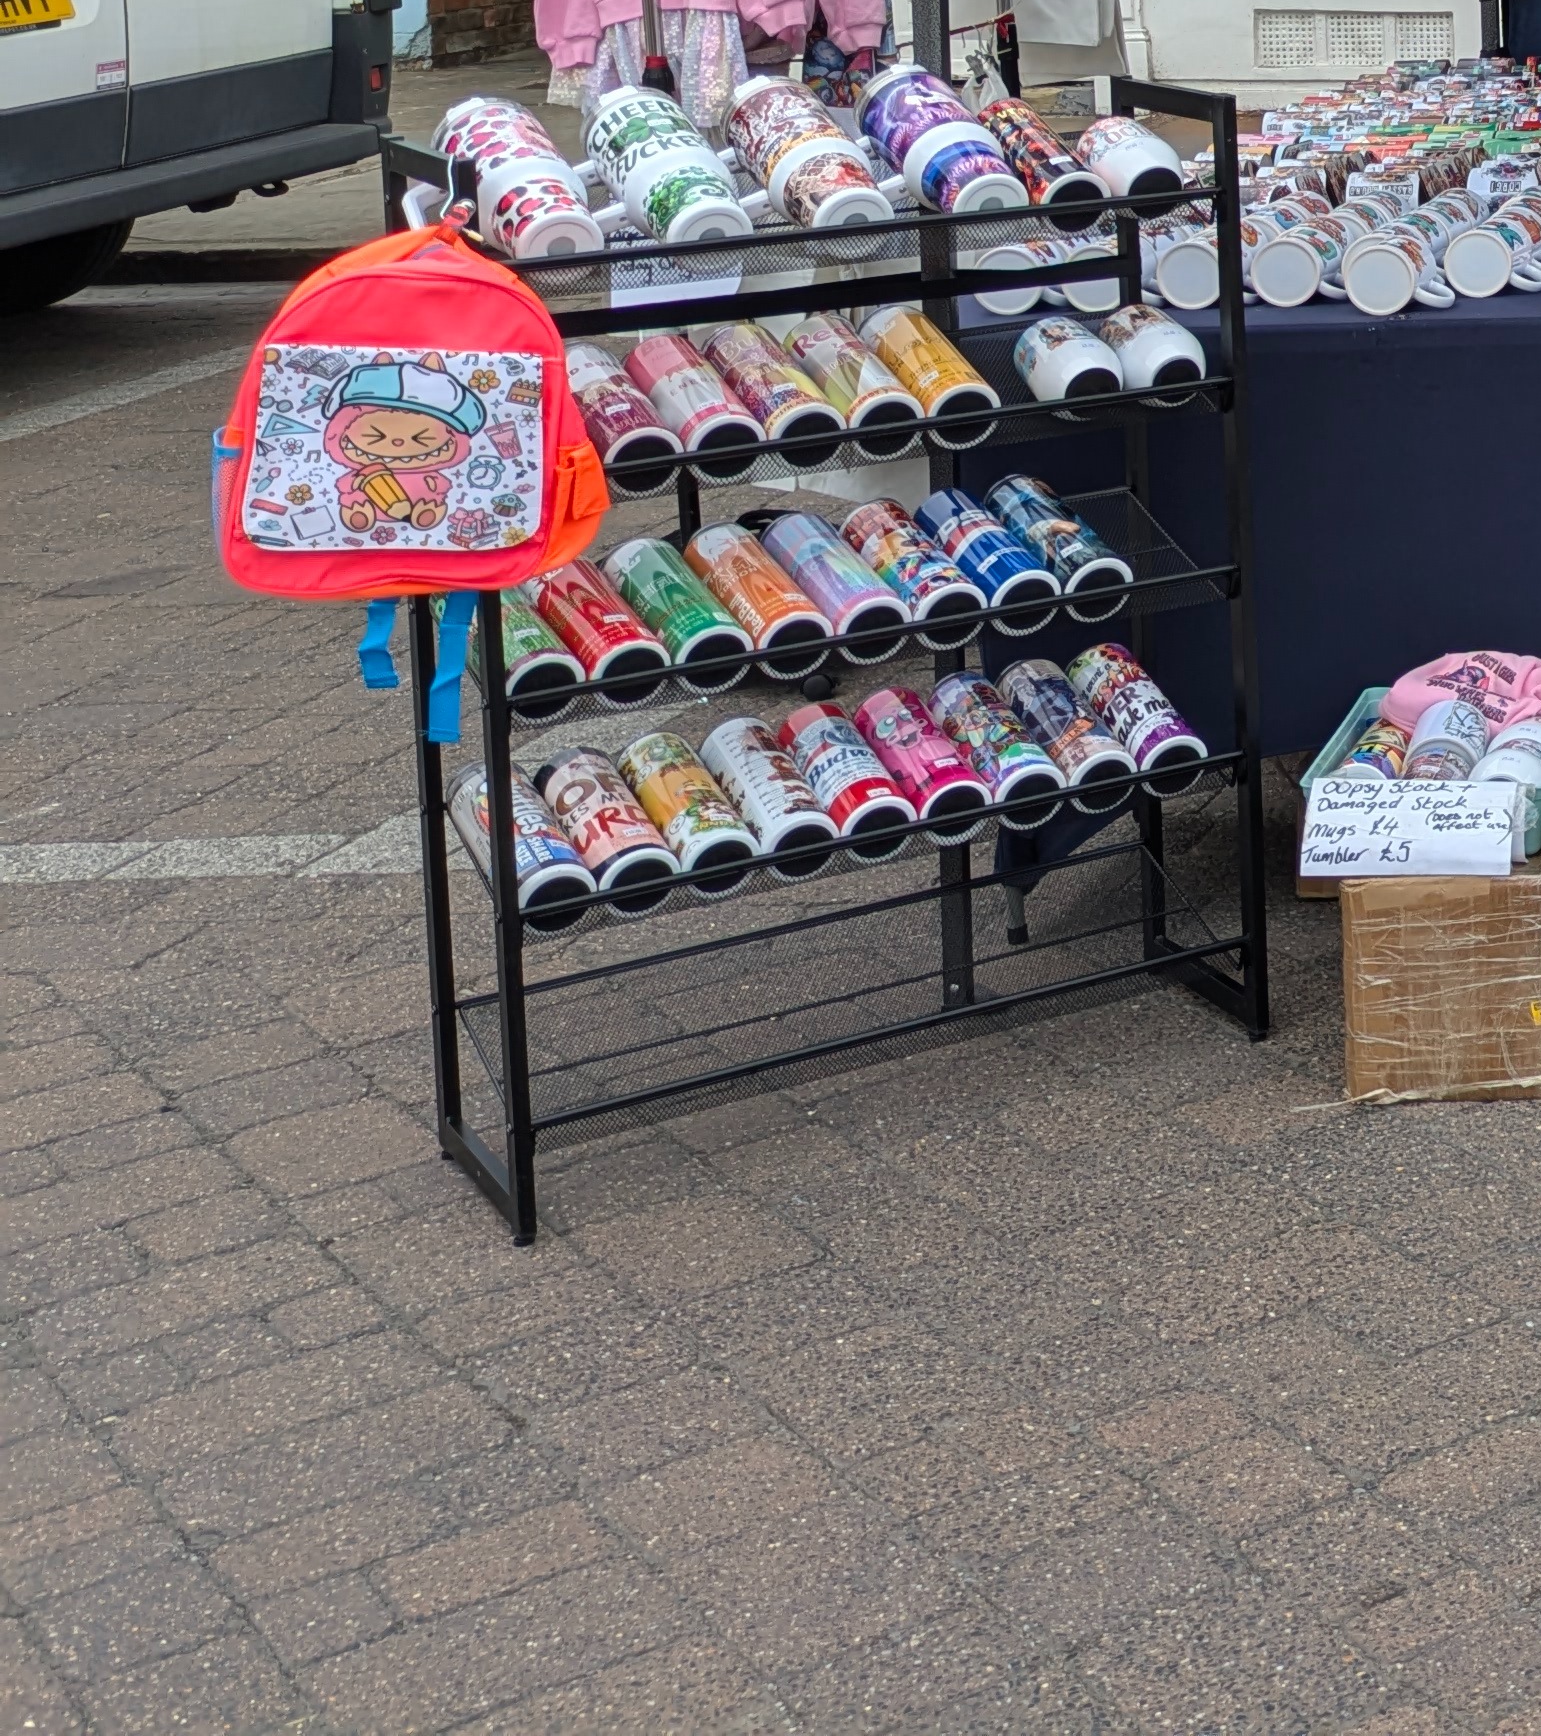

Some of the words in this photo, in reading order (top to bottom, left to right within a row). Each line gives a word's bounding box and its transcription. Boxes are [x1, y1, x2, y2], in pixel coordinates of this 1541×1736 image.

[1389, 781, 1453, 793] Stock
[1318, 796, 1404, 814] Damaged
[1411, 796, 1467, 810] Stock
[1466, 809, 1493, 820] not
[1309, 823, 1356, 844] Mugs
[1369, 815, 1399, 836] £4
[1301, 845, 1370, 865] Tumbler
[1379, 841, 1413, 862] £5
